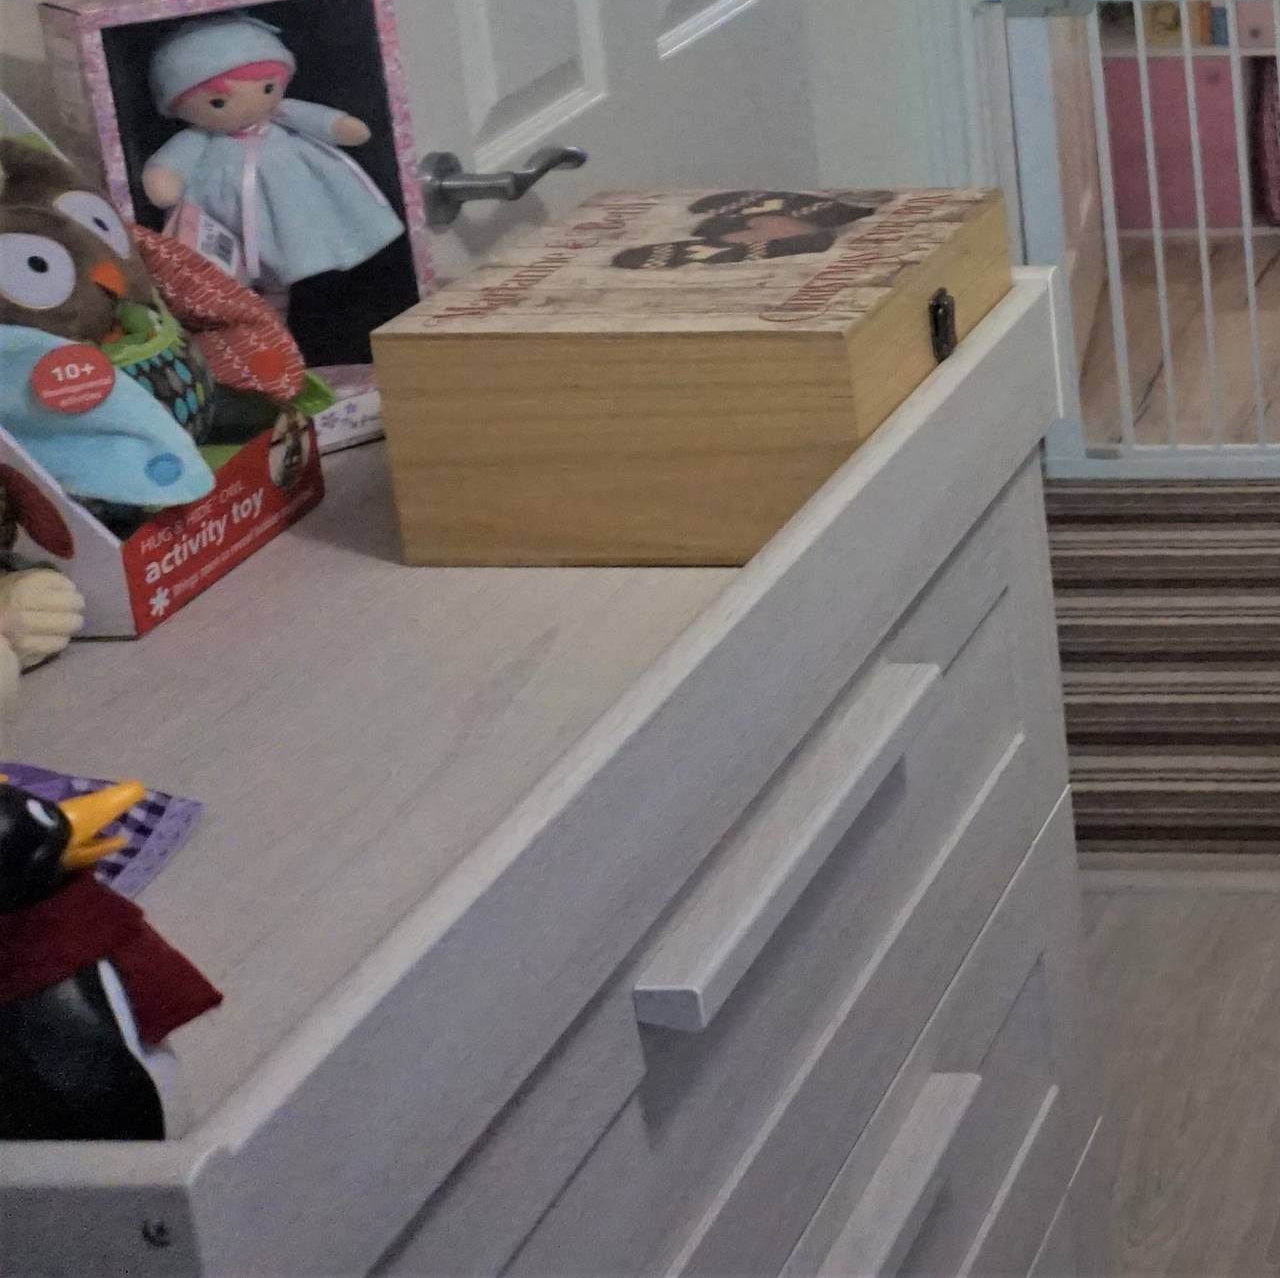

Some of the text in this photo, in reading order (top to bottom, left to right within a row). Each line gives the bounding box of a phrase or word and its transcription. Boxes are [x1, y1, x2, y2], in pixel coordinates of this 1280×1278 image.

[51, 363, 96, 383] 10+
[140, 526, 176, 554] HUG
[144, 514, 228, 584] activity
[230, 487, 265, 519] toy
